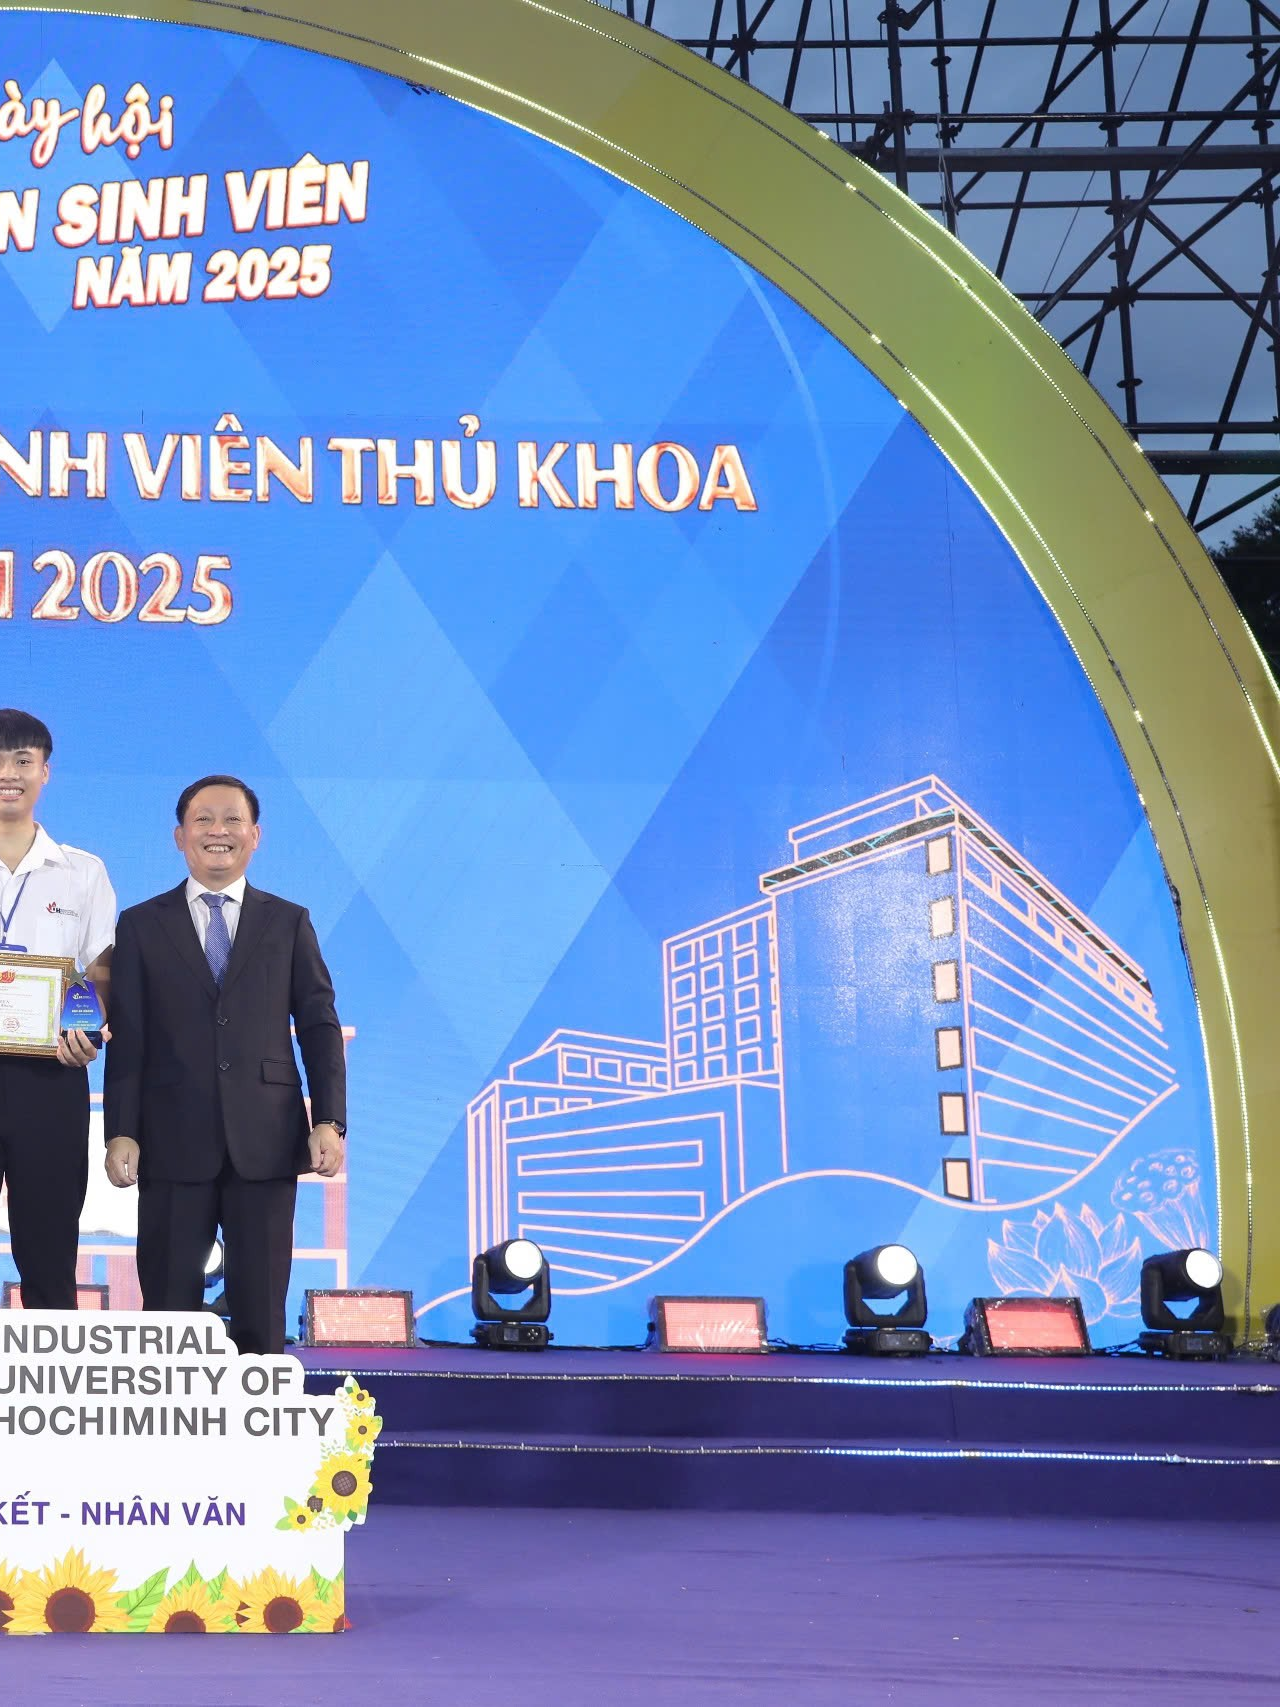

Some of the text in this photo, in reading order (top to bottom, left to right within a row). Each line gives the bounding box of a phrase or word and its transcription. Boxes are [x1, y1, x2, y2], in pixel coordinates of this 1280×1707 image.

[80, 81, 175, 160] hội
[53, 173, 209, 247] SINH
[223, 151, 370, 234] VIÊN
[72, 243, 334, 310] NĂM 2025
[122, 412, 315, 504] VIÊN
[326, 413, 498, 511] THỦ
[516, 440, 759, 513] KHOA
[30, 548, 234, 626] 2025
[241, 1365, 293, 1396] OF
[243, 1406, 335, 1437] CITY
[81, 1495, 170, 1526] NHÂN
[181, 1496, 246, 1526] VĂN
